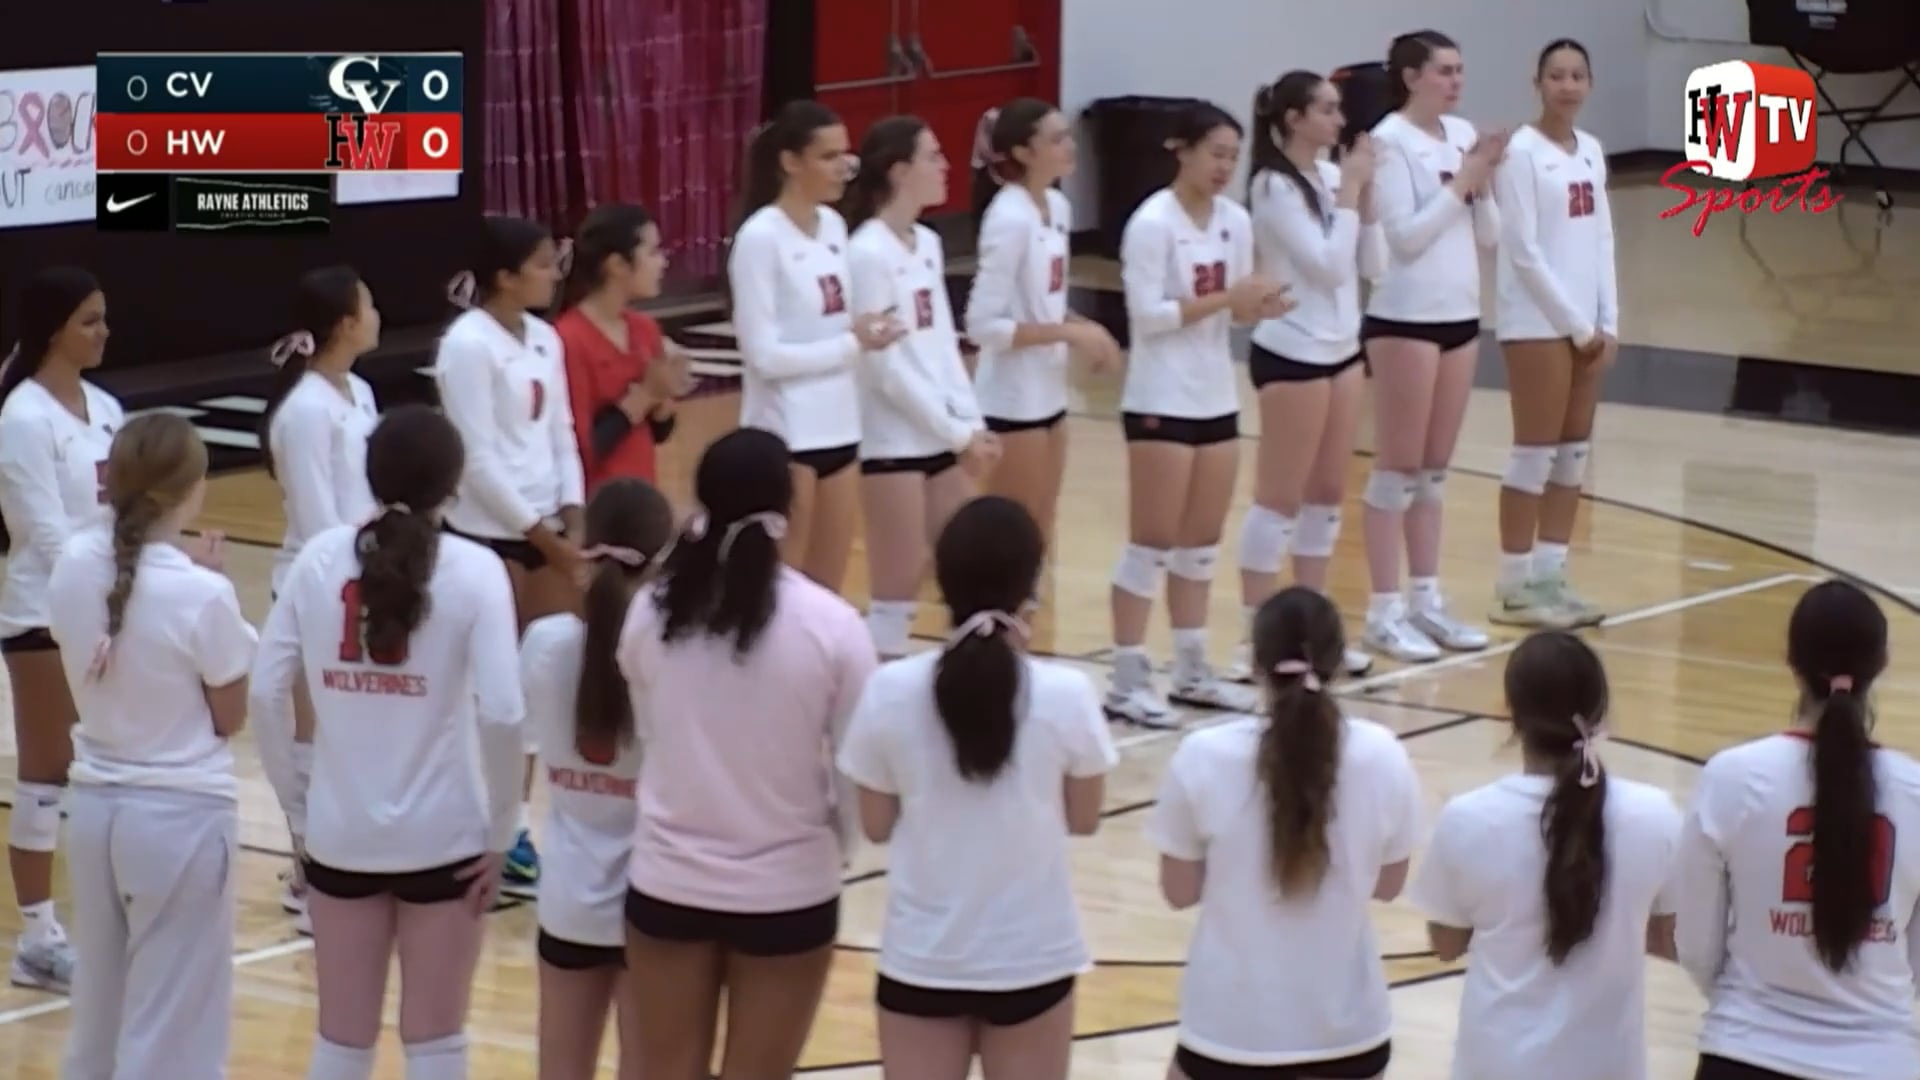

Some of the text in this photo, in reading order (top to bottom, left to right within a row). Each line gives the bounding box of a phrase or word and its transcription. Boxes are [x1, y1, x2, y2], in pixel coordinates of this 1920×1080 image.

[0, 167, 31, 209] UT
[1567, 181, 1595, 218] 26
[340, 578, 411, 666] 1
[322, 668, 428, 697] WOLVERINES
